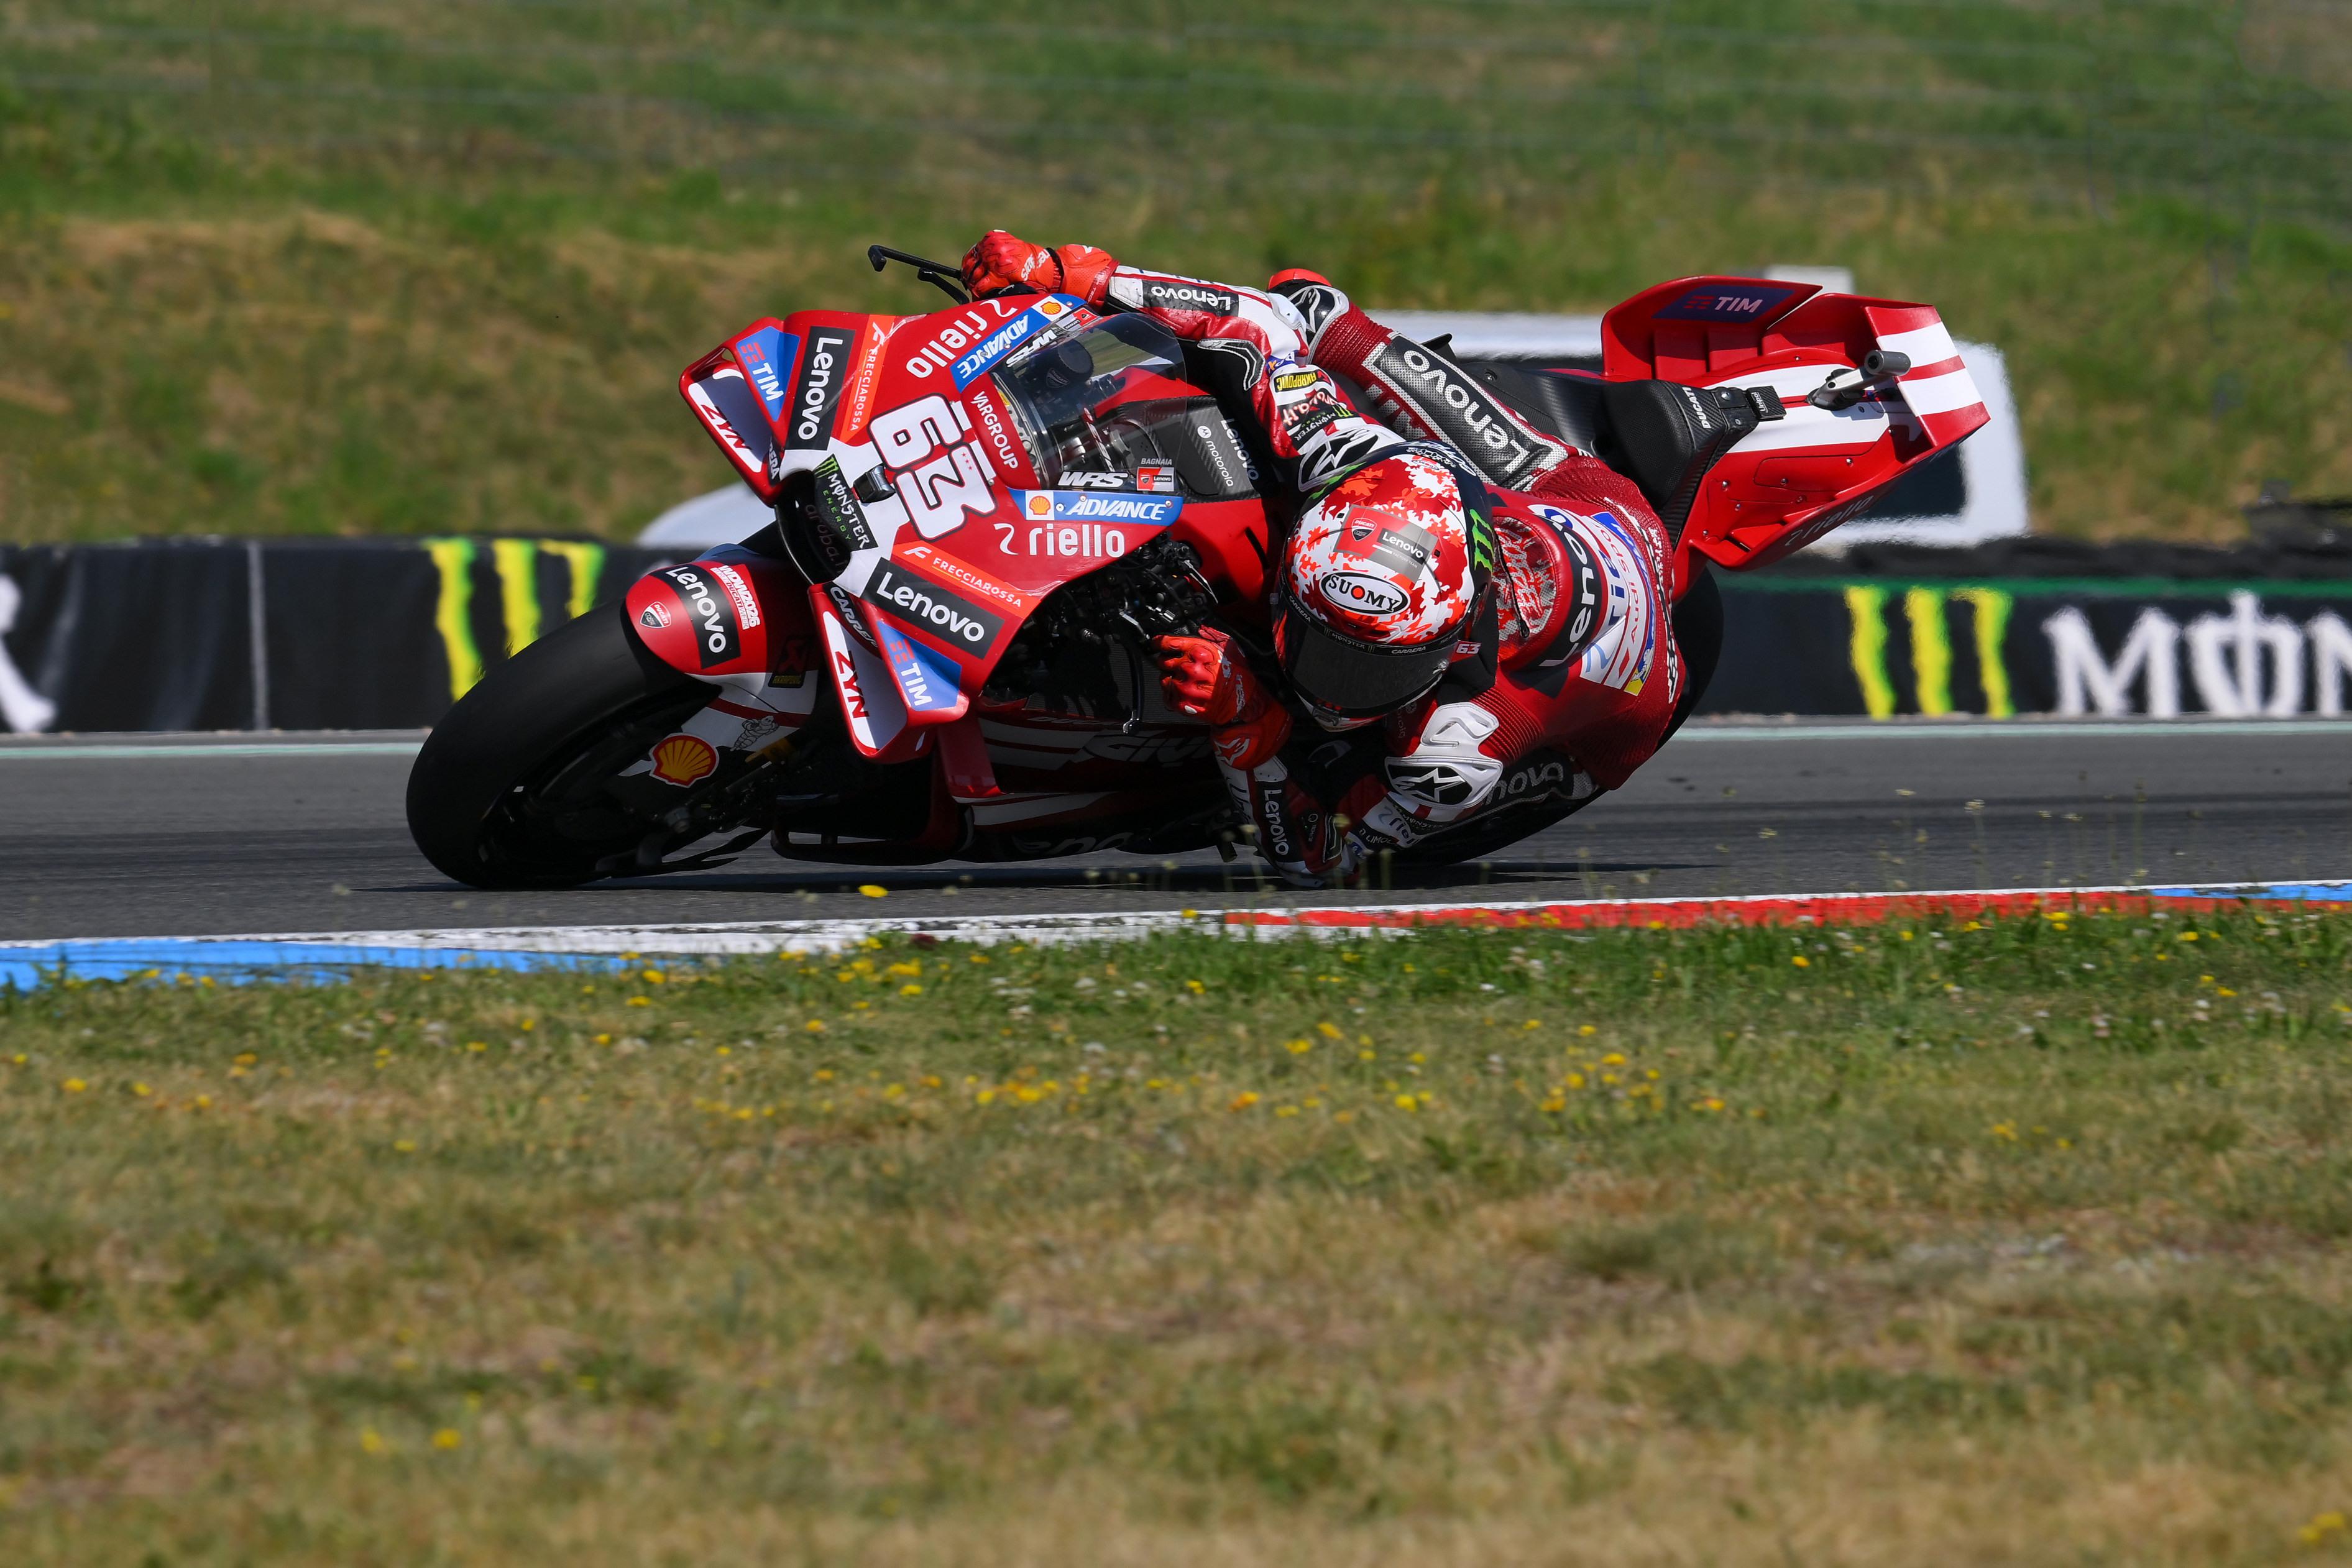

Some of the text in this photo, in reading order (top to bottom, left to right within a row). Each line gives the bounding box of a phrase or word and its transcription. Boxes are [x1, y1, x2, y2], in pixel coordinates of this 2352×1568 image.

[1151, 287, 1231, 310] Lenovo
[1714, 296, 1763, 313] TIM
[906, 311, 988, 378] riello
[957, 315, 1029, 378] ADVANCE
[1006, 329, 1057, 367] WRS
[752, 362, 784, 401] TIM
[798, 337, 843, 439] Lenovo
[850, 348, 878, 431] FRECCIAROSSA
[701, 404, 752, 450] ZYN
[970, 391, 1018, 469] VARGROUP
[1296, 411, 1336, 441] MONSTER
[1403, 349, 1535, 475] Lenovo
[1682, 387, 1711, 428] DUCATI
[868, 393, 998, 541] 63
[1206, 441, 1233, 487] motorola
[1221, 419, 1259, 480] Lenovo
[1058, 471, 1128, 487] WRS
[823, 490, 852, 539] ENERGY
[828, 474, 870, 549] MONSTER
[1066, 500, 1166, 520] ADVANCE
[1354, 520, 1375, 528] DUCATI
[1029, 521, 1125, 558] riello
[1382, 531, 1423, 559] Lenovo
[719, 565, 761, 628] WDW2026
[933, 557, 1021, 608] FRECCIAROSSA
[1329, 575, 1400, 612] SUOMY
[655, 603, 669, 625] DUCATI
[666, 566, 726, 653] Lenovo
[876, 571, 985, 643] Lenovo
[1289, 595, 1312, 622] CARRERA
[1331, 633, 1365, 649] MONSTER
[1391, 646, 1426, 654] CARRERA
[1456, 643, 1481, 654] 63
[835, 650, 870, 719] ZYN
[901, 663, 932, 707] TIM
[1264, 789, 1289, 856] Lenovo
